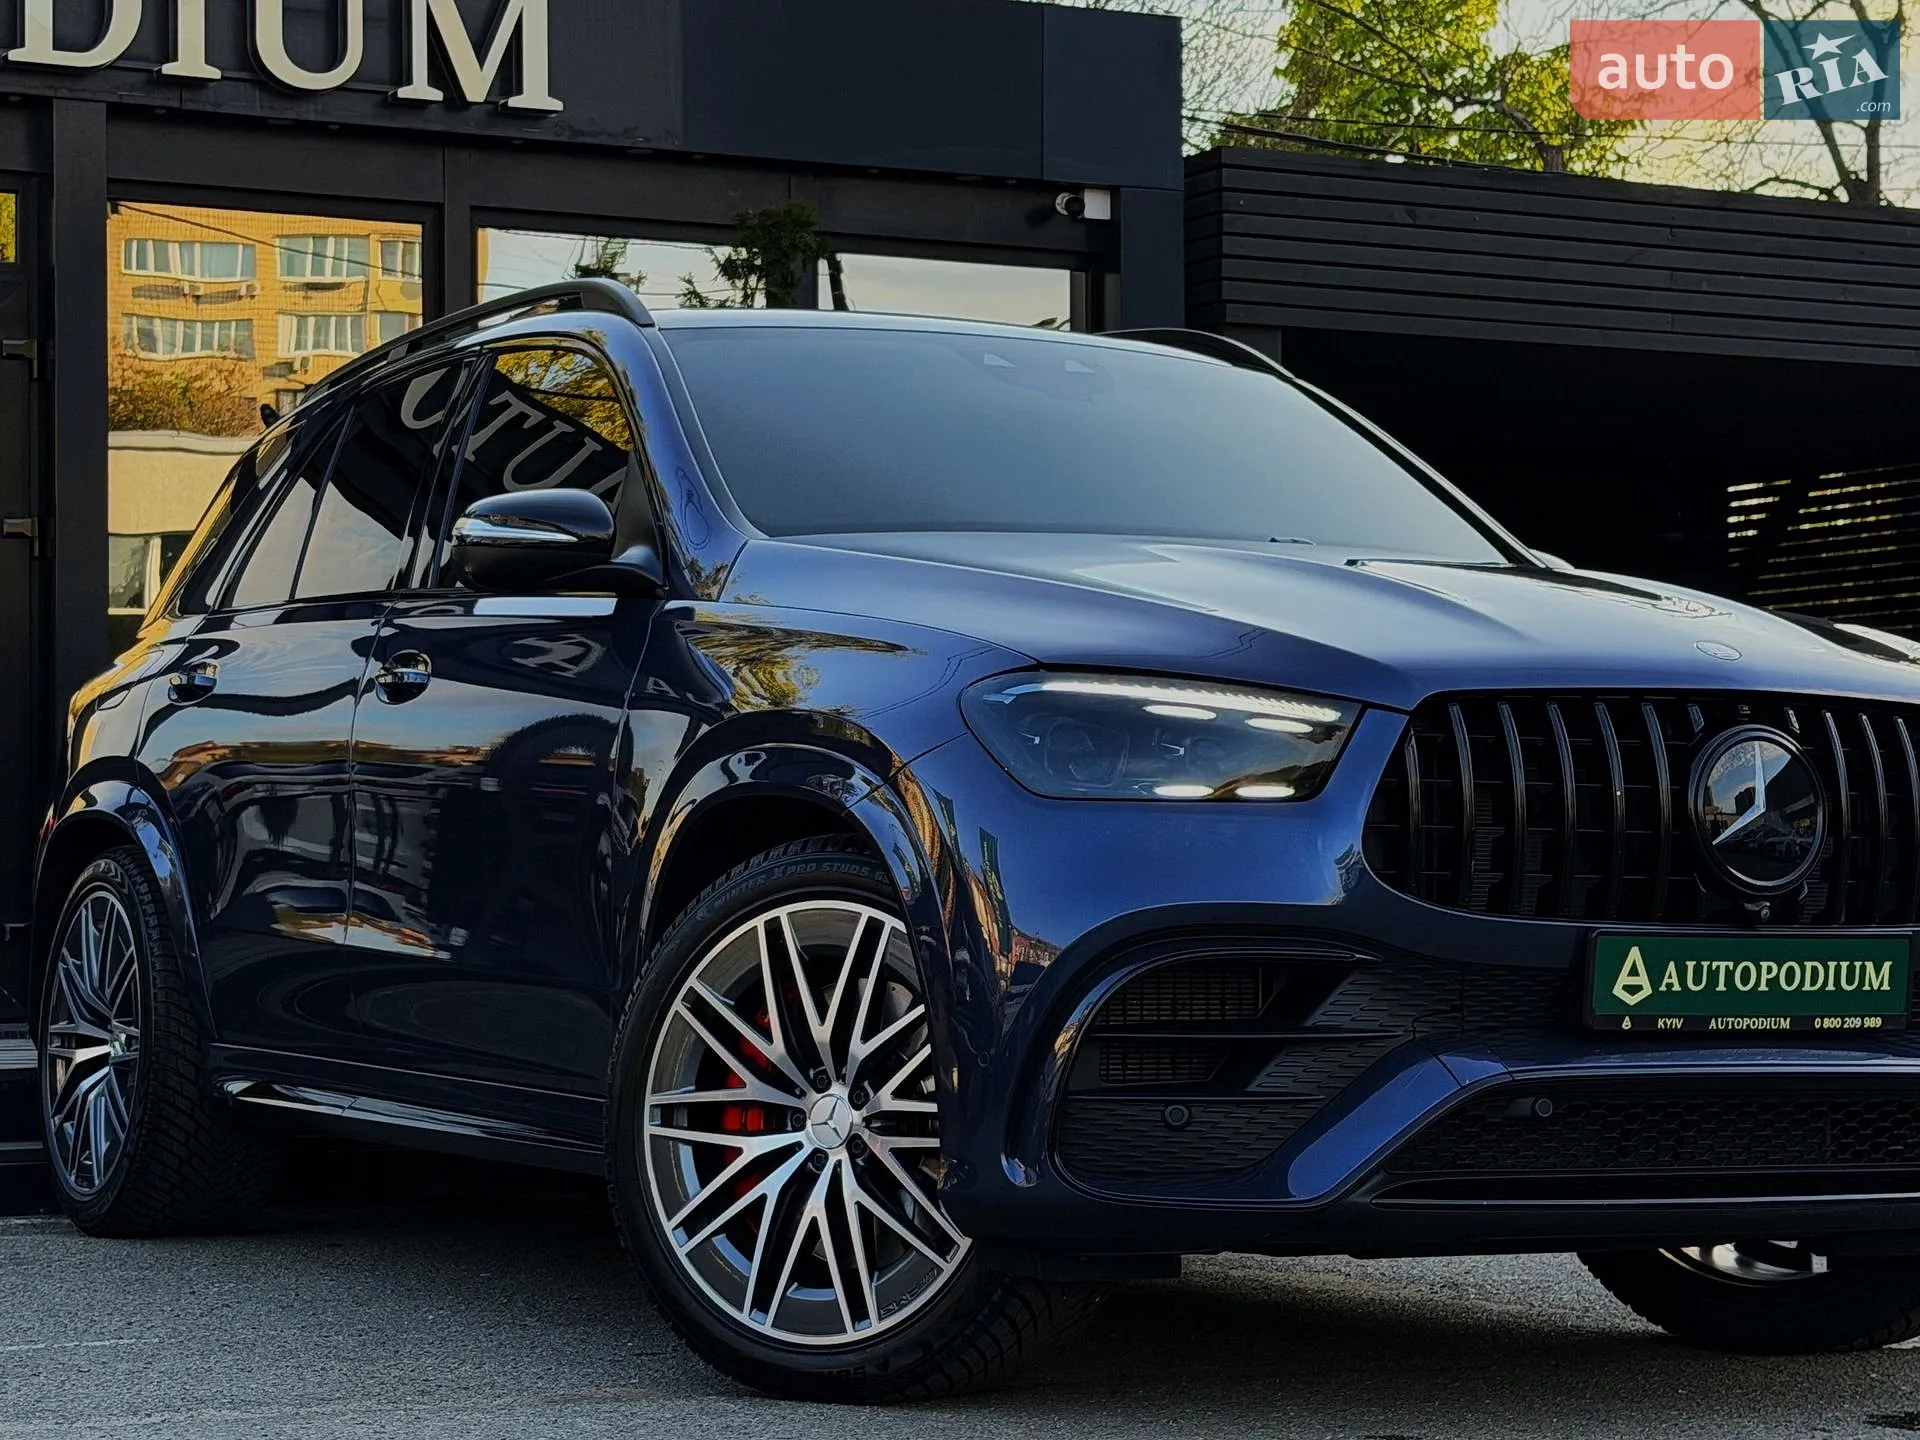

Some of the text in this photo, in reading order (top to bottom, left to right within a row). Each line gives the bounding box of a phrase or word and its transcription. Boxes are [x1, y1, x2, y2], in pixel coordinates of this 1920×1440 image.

[1658, 960, 1893, 992] AUTOPODIUM
[1657, 1017, 1684, 1030] KYIV
[1708, 1017, 1791, 1030] AUTOPODIUM
[1823, 1017, 1842, 1029] 800
[1843, 1017, 1862, 1029] 209
[1863, 1016, 1882, 1029] 989
